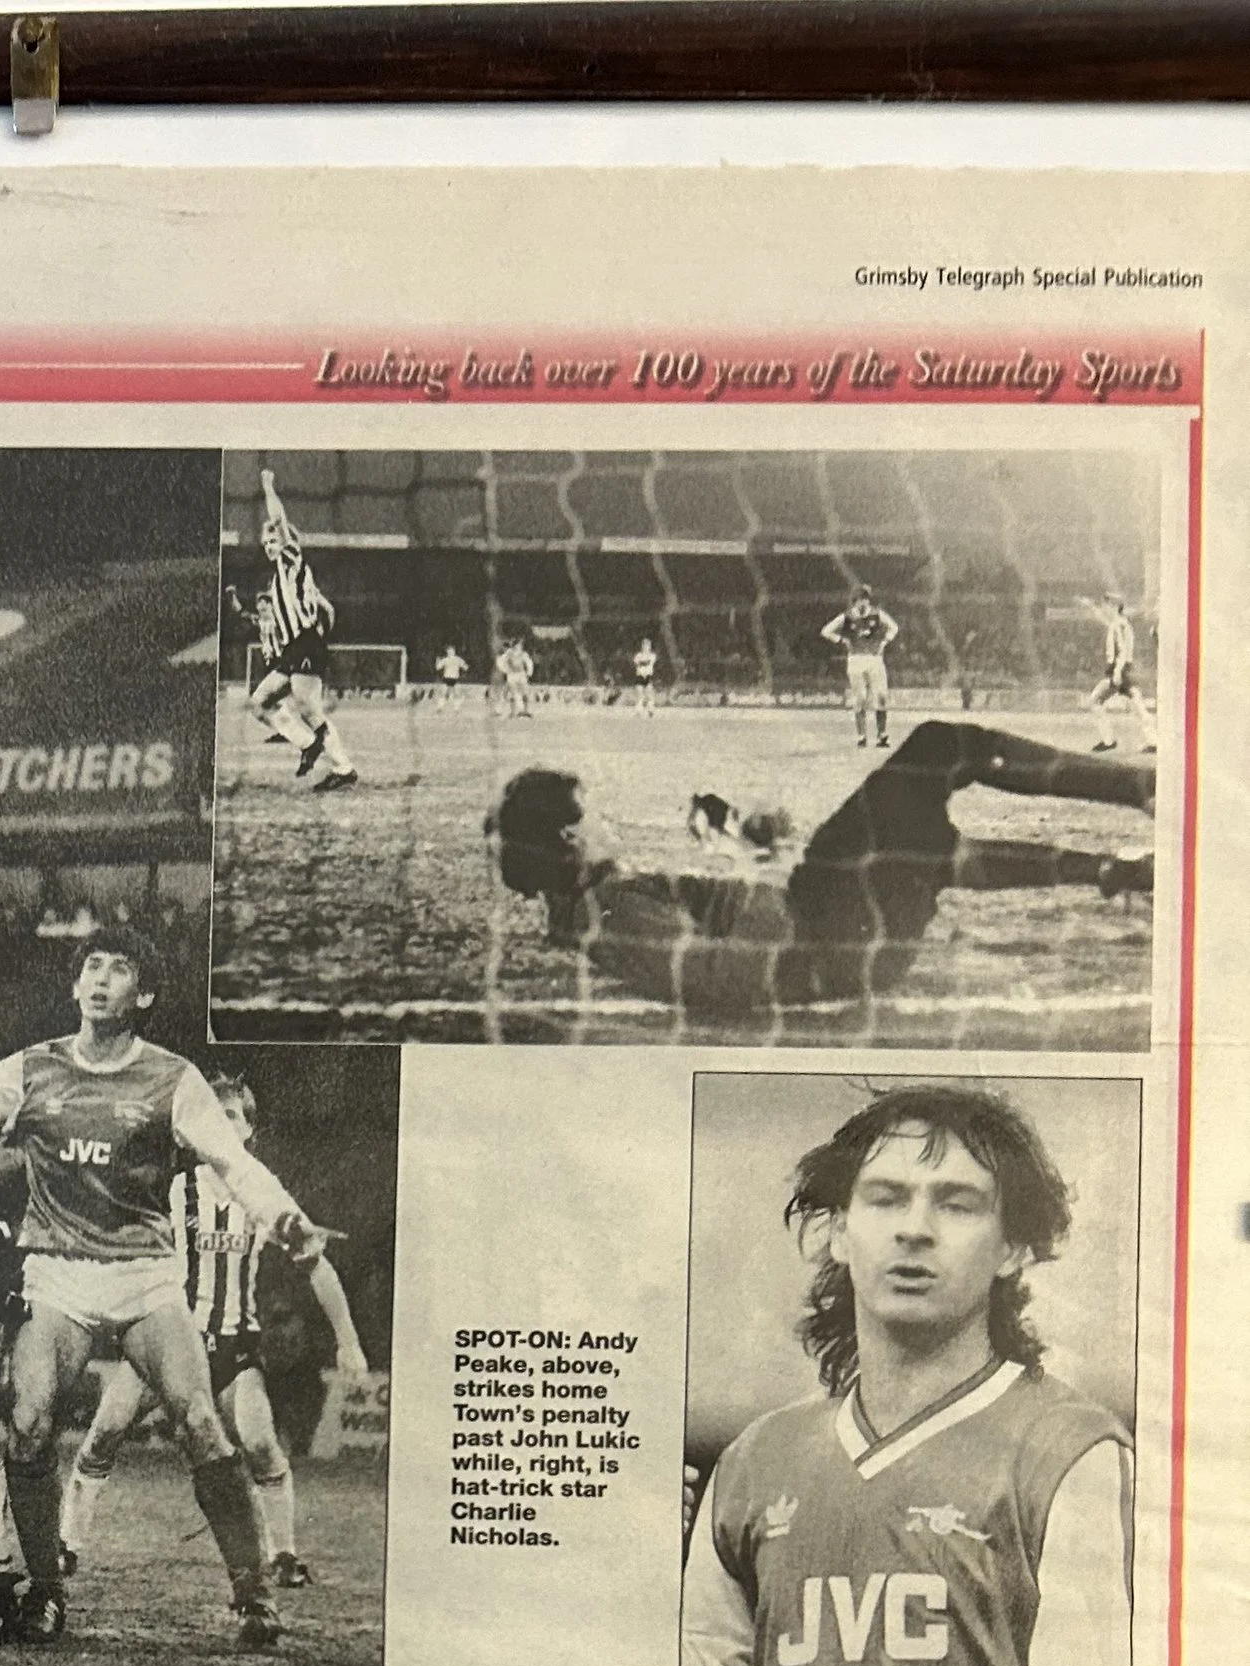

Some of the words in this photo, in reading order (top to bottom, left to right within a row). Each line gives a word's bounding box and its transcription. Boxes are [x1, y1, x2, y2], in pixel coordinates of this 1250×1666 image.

[854, 264, 929, 291] Grimsby
[937, 264, 1025, 291] Telegraph
[1032, 265, 1096, 291] Special
[1103, 266, 1203, 288] Publication
[314, 347, 448, 397] Looking
[458, 347, 537, 387] back
[544, 358, 618, 388] over
[631, 348, 703, 387] 100
[705, 358, 794, 399] years
[806, 348, 849, 398] of
[848, 347, 898, 386] the
[908, 347, 1062, 399] Saturday
[1073, 349, 1183, 400] Sports
[59, 1138, 113, 1167] JVC
[453, 1328, 571, 1350] SPOT-ON:
[576, 1330, 639, 1354] Andy
[453, 1353, 534, 1377] Peake,
[540, 1354, 620, 1379] above,
[452, 1378, 535, 1399] strikes
[540, 1379, 608, 1400] home
[452, 1402, 535, 1423] Town's
[541, 1404, 631, 1428] penalty
[451, 1428, 504, 1450] past
[509, 1428, 569, 1448] John
[575, 1429, 640, 1450] Lukic
[450, 1451, 522, 1476] while,
[528, 1453, 592, 1477] right,
[598, 1454, 620, 1474] is
[450, 1475, 554, 1497] hat-trick
[559, 1478, 608, 1498] star
[449, 1500, 537, 1522] Charlie
[449, 1525, 560, 1547] Nicholas.
